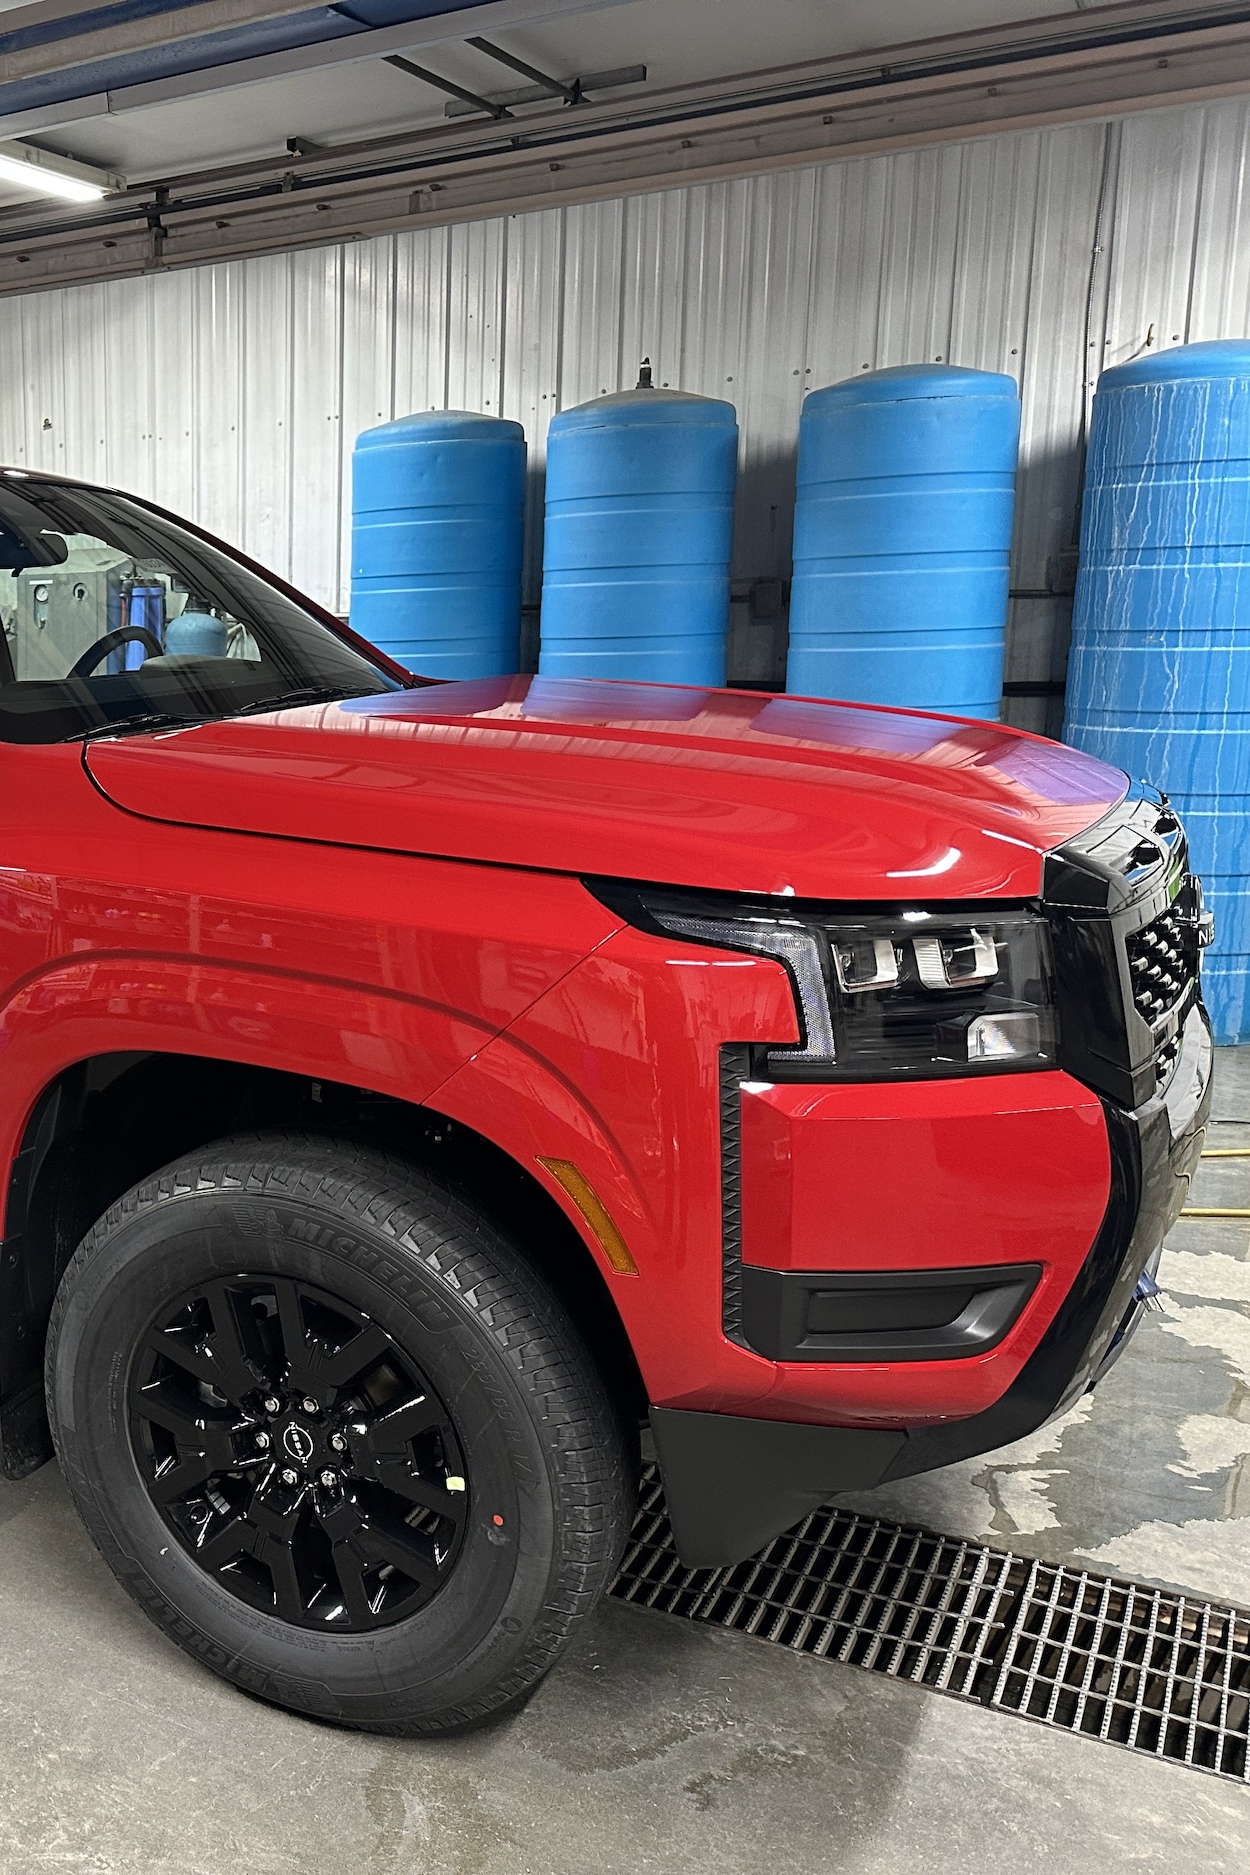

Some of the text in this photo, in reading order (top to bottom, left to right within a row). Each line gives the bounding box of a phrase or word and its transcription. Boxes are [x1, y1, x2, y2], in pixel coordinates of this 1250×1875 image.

[288, 1217, 450, 1325] MICHELIN
[289, 1421, 308, 1464] NISSAN
[132, 1578, 268, 1689] MICHELIN
